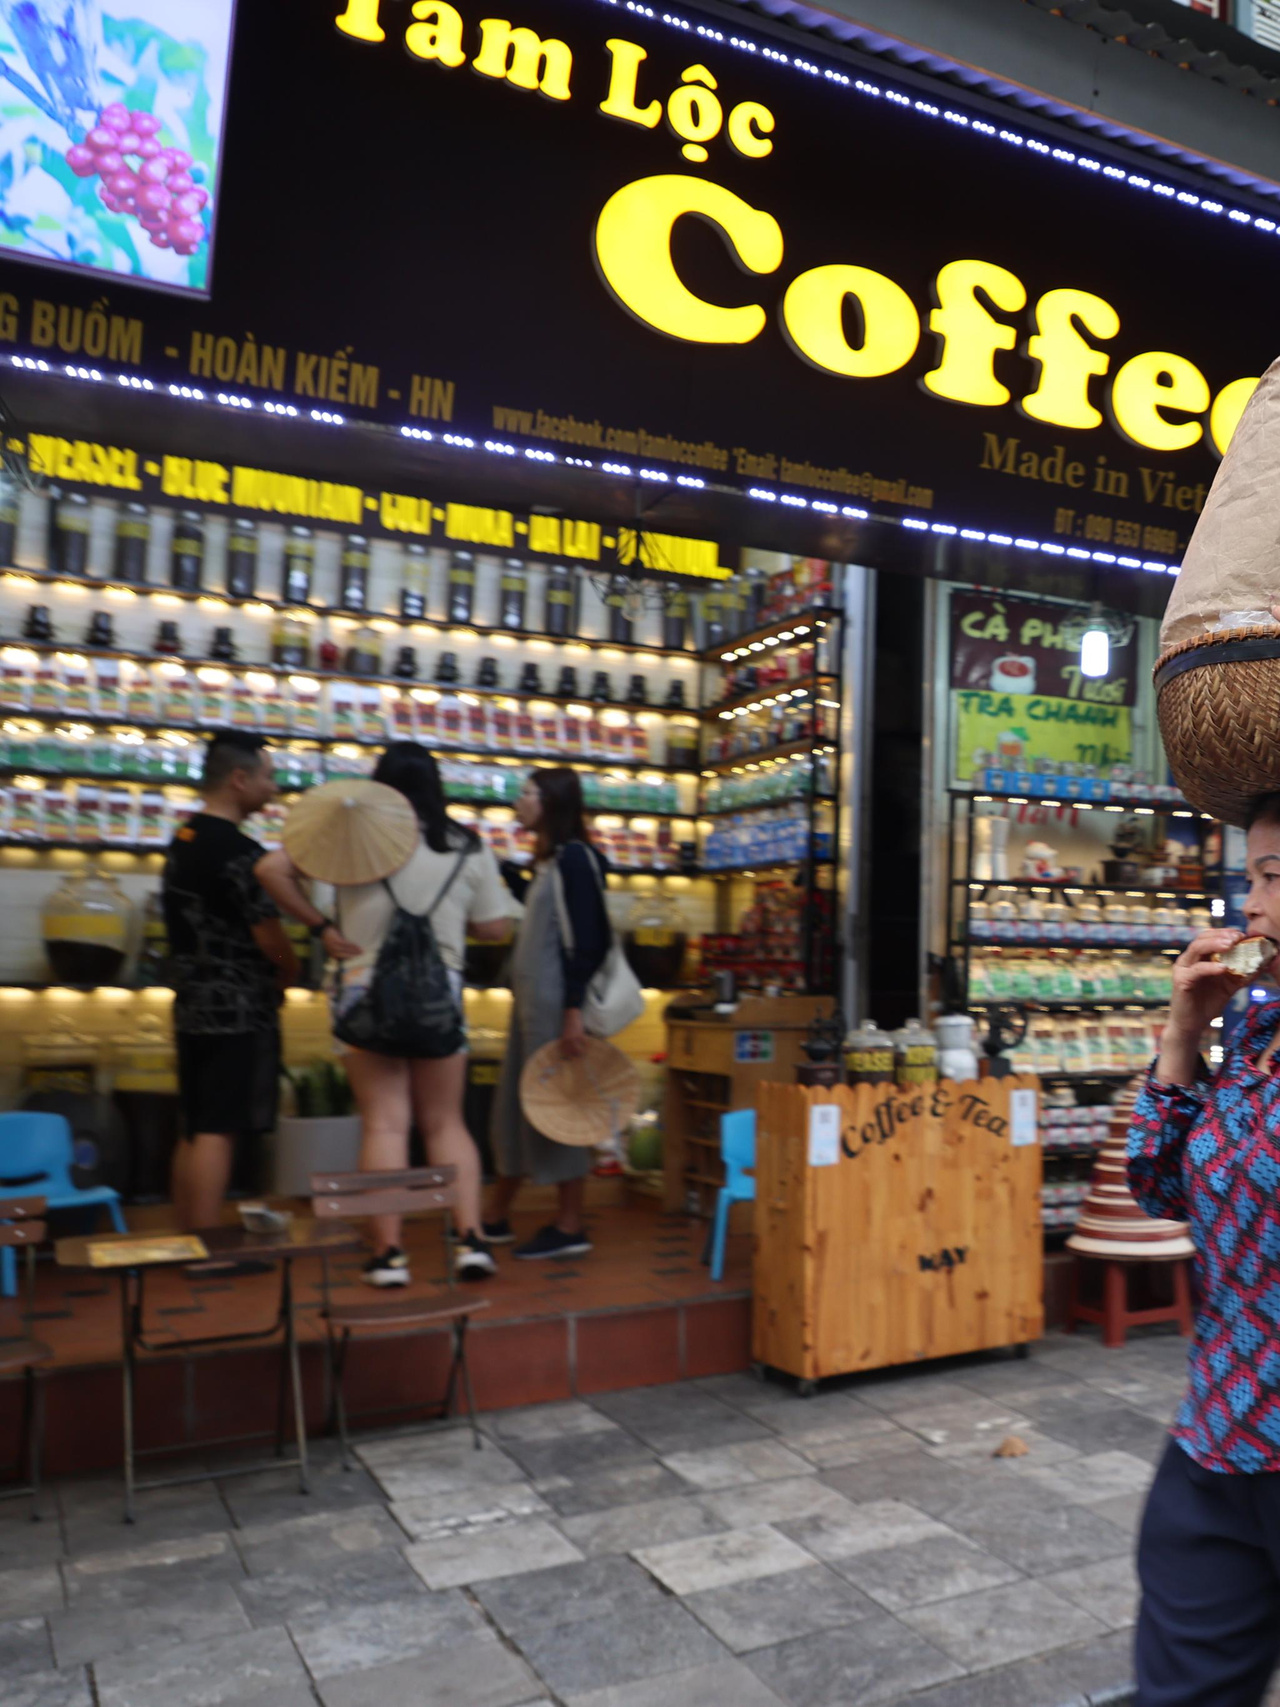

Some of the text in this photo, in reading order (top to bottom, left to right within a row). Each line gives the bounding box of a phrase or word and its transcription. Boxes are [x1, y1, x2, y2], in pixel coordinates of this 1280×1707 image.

[599, 38, 776, 163] Lộc
[31, 296, 143, 366] BUỒM
[189, 331, 286, 392] HOÀN
[295, 346, 380, 408] KIẾM
[409, 374, 455, 422] HN
[979, 431, 1086, 489] Made
[1093, 455, 1129, 498] in
[961, 602, 1010, 642] CÀ
[841, 1088, 1009, 1159] Coffee & Tea
